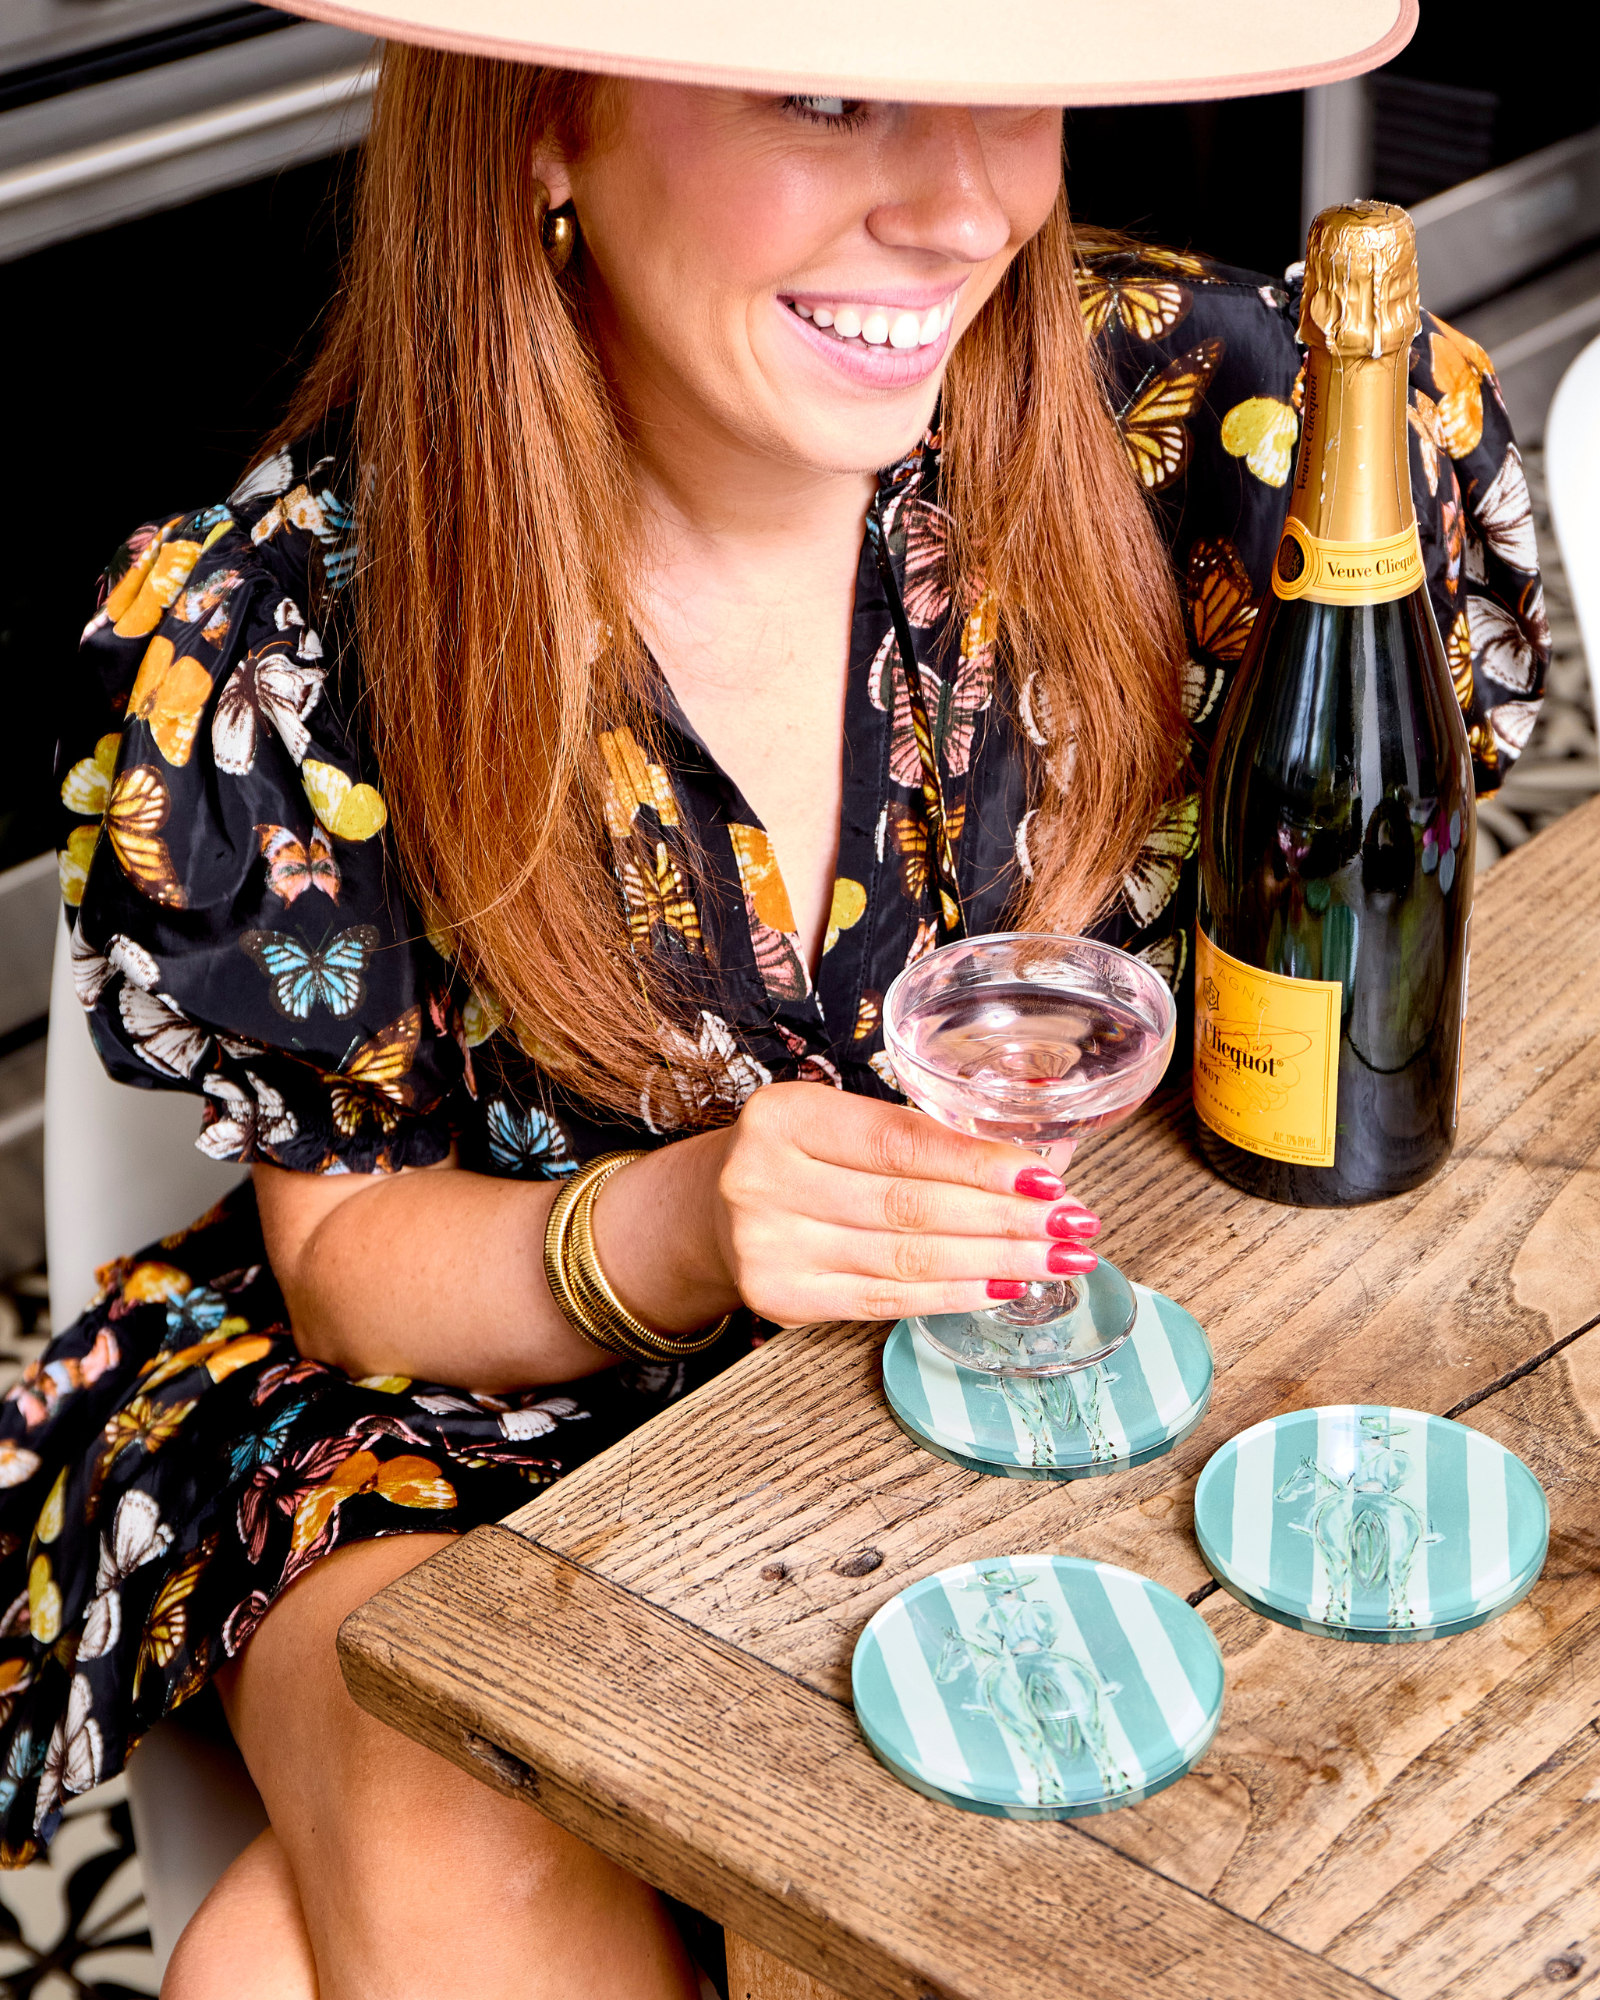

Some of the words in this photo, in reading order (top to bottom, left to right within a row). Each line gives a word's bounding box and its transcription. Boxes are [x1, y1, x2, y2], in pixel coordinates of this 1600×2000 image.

[1296, 446, 1312, 490] Veuve
[1304, 374, 1319, 442] Clicquot
[1327, 561, 1373, 578] Veuve
[1375, 548, 1418, 576] Clicquot
[1209, 1093, 1241, 1118] FRANCE
[1301, 1155, 1326, 1163] FRANCE
